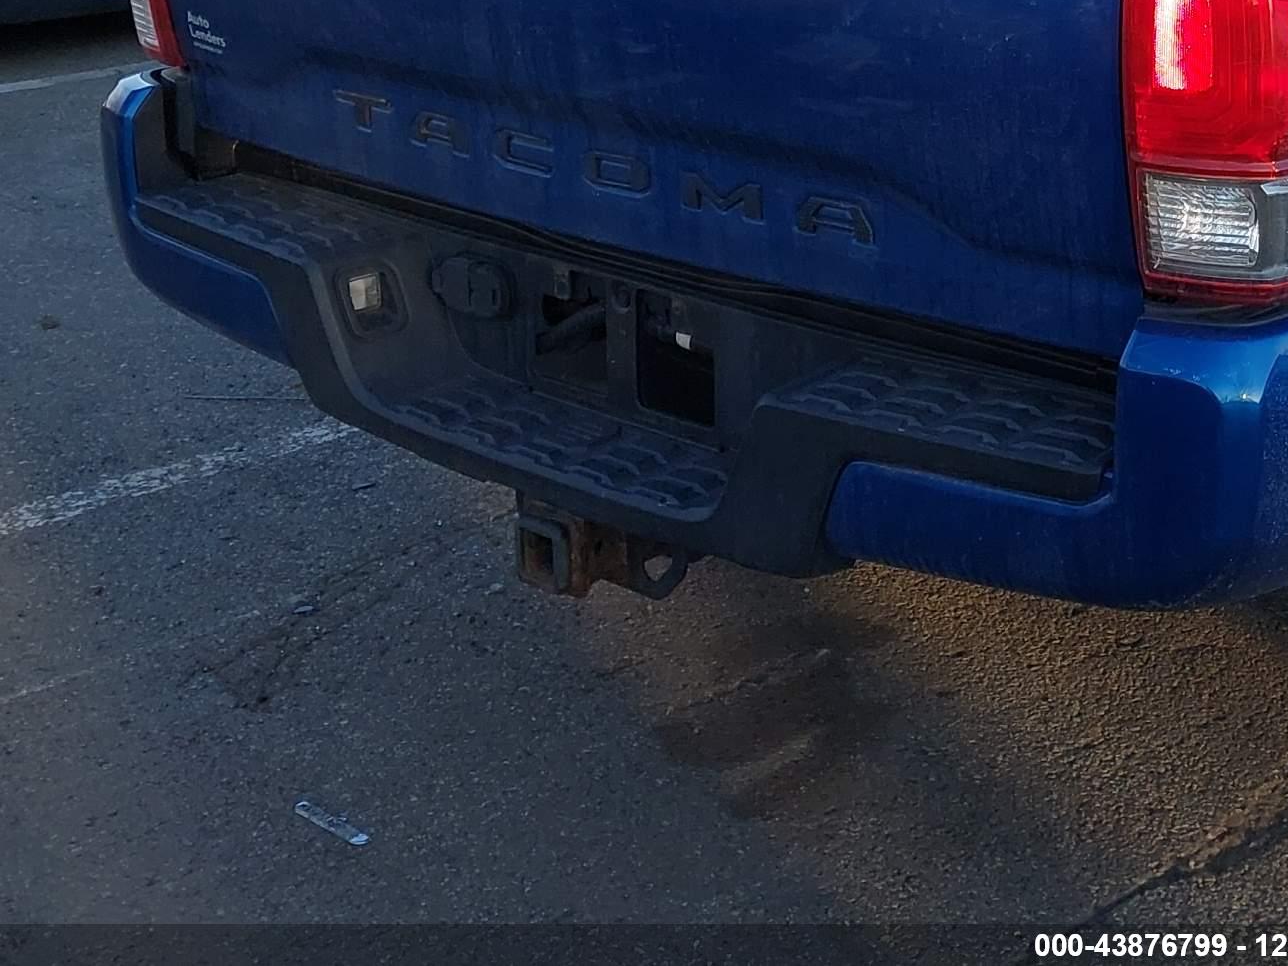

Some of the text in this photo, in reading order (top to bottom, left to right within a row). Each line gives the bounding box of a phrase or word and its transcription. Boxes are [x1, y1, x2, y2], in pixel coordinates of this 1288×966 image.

[187, 10, 210, 29] Auto
[188, 24, 226, 47] Lenders
[333, 89, 877, 250] TACOMA
